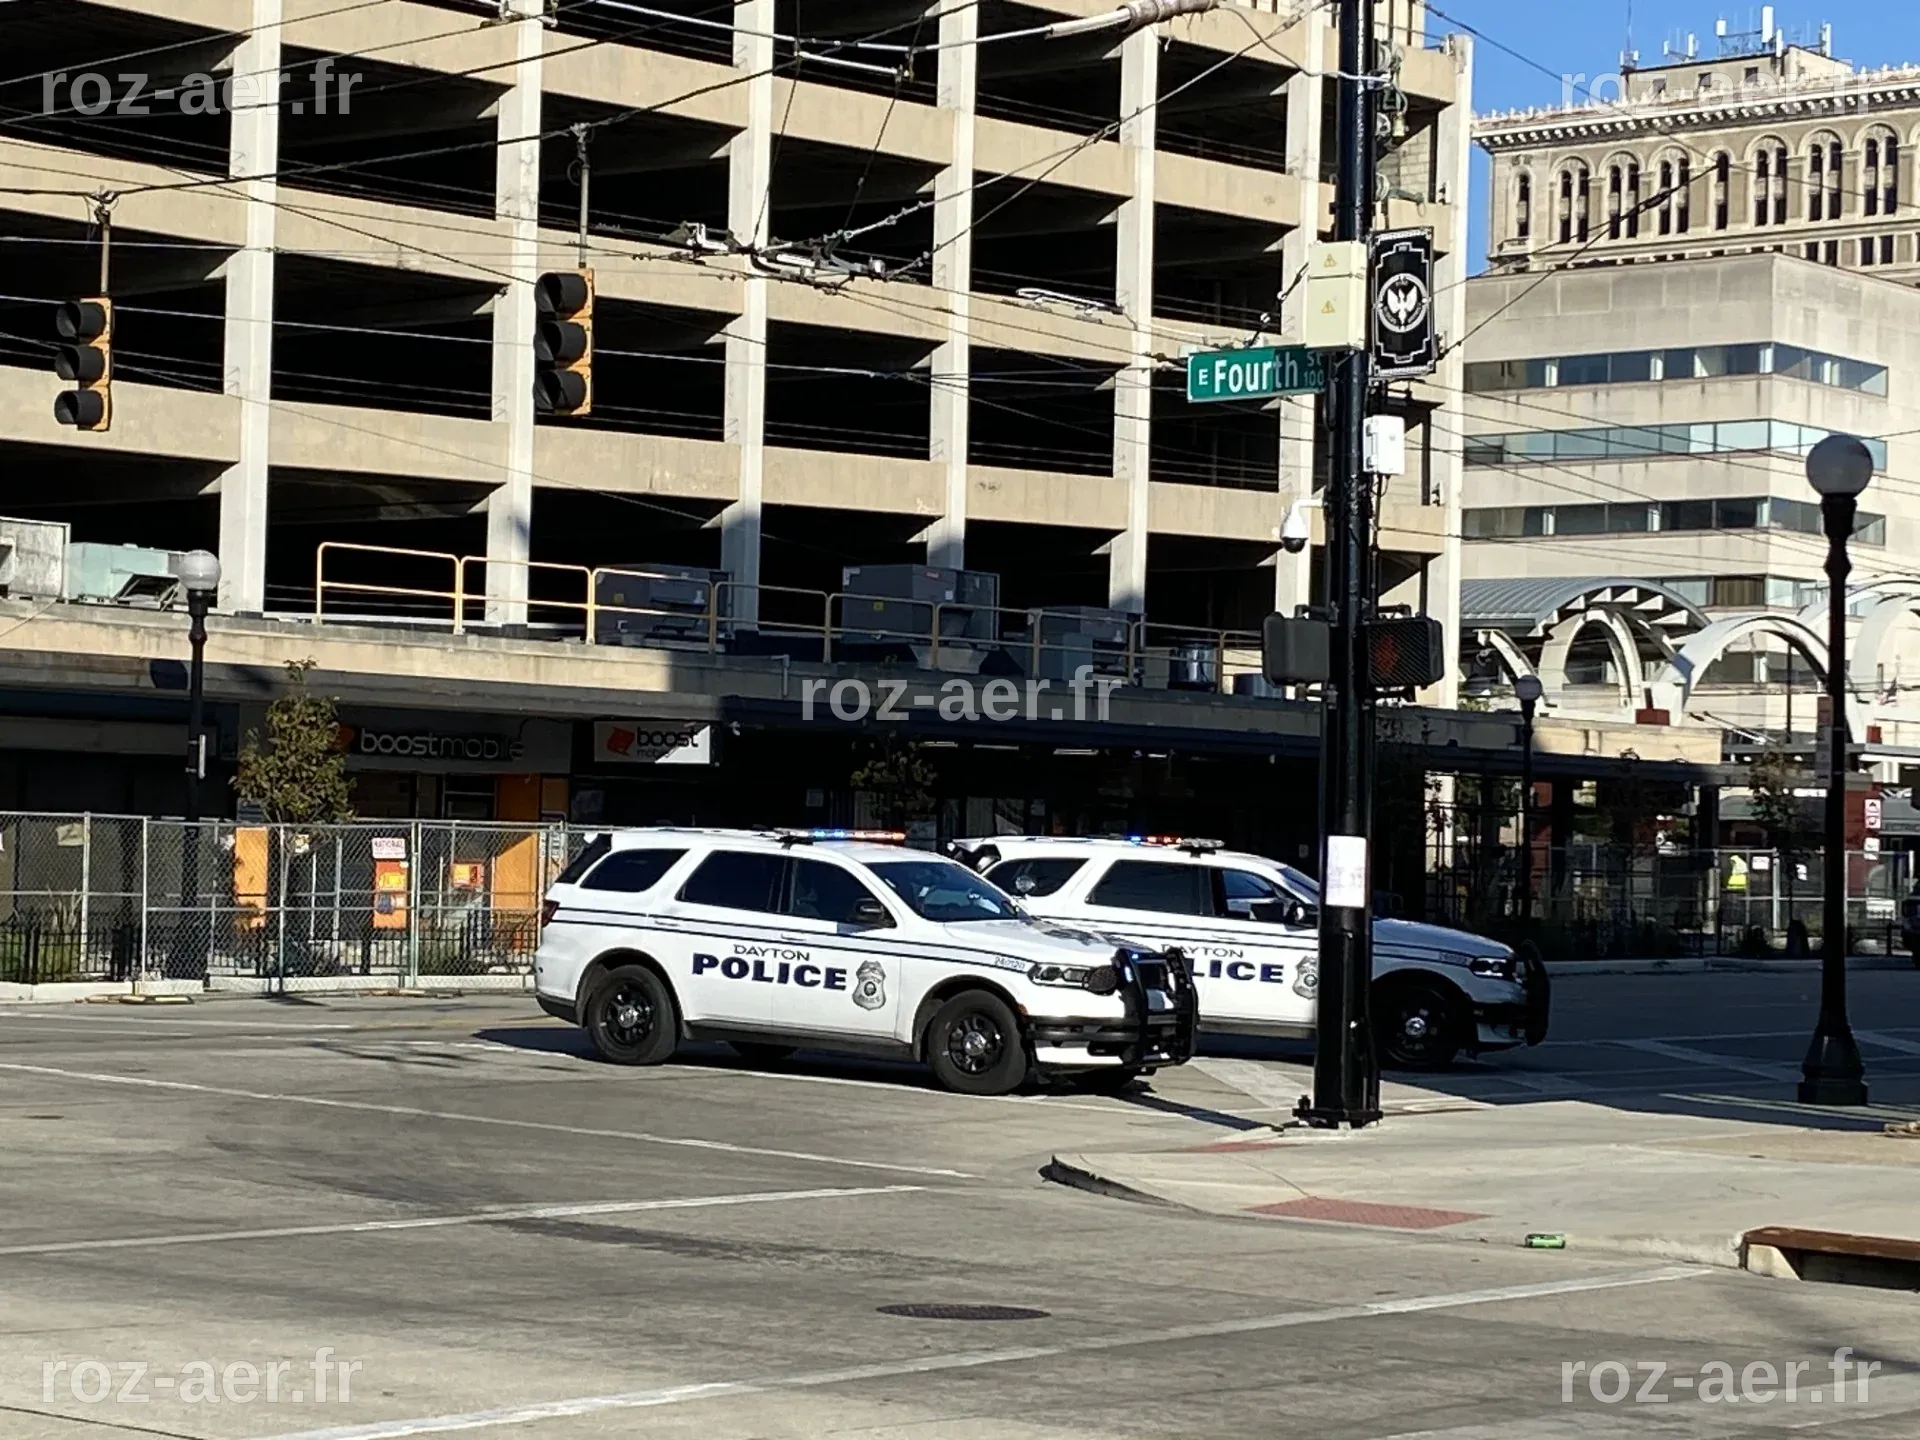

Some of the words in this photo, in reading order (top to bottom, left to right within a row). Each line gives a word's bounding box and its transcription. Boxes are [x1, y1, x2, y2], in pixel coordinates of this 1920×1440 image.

[1198, 368, 1209, 386] E
[1214, 350, 1299, 394] Fourth
[1306, 351, 1324, 367] St
[1303, 370, 1325, 387] 100
[636, 726, 699, 748] boost
[733, 944, 810, 962] DAYTON
[692, 952, 848, 992] POLICE
[1184, 957, 1284, 984] LICE
